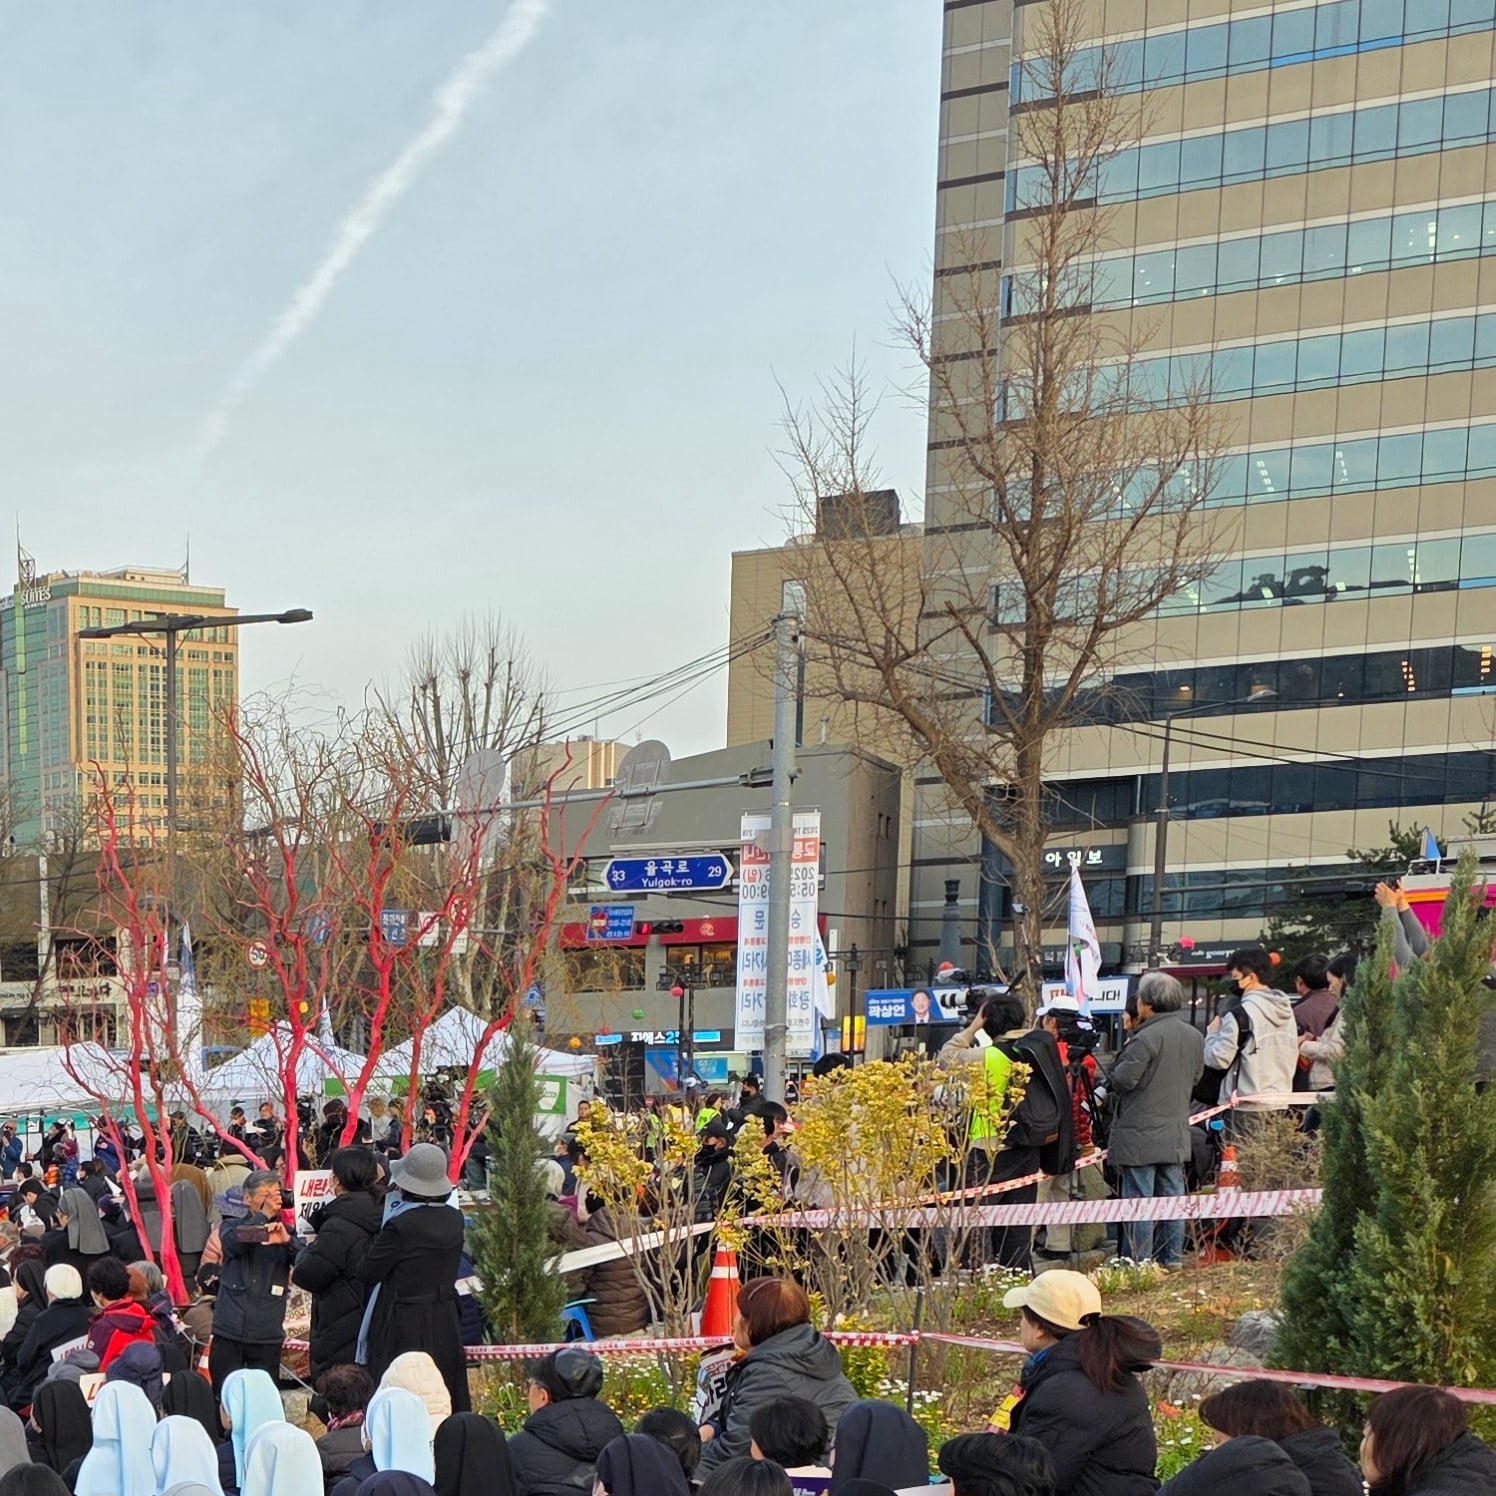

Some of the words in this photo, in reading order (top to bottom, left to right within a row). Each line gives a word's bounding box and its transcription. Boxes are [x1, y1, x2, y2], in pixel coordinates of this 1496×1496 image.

[1045, 850, 1103, 868] 아일보
[644, 860, 690, 877] 율곡로
[707, 866, 722, 878] 29
[611, 870, 625, 882] 33
[641, 877, 693, 889] Yulgok-ro
[868, 1004, 906, 1018] 곽상언
